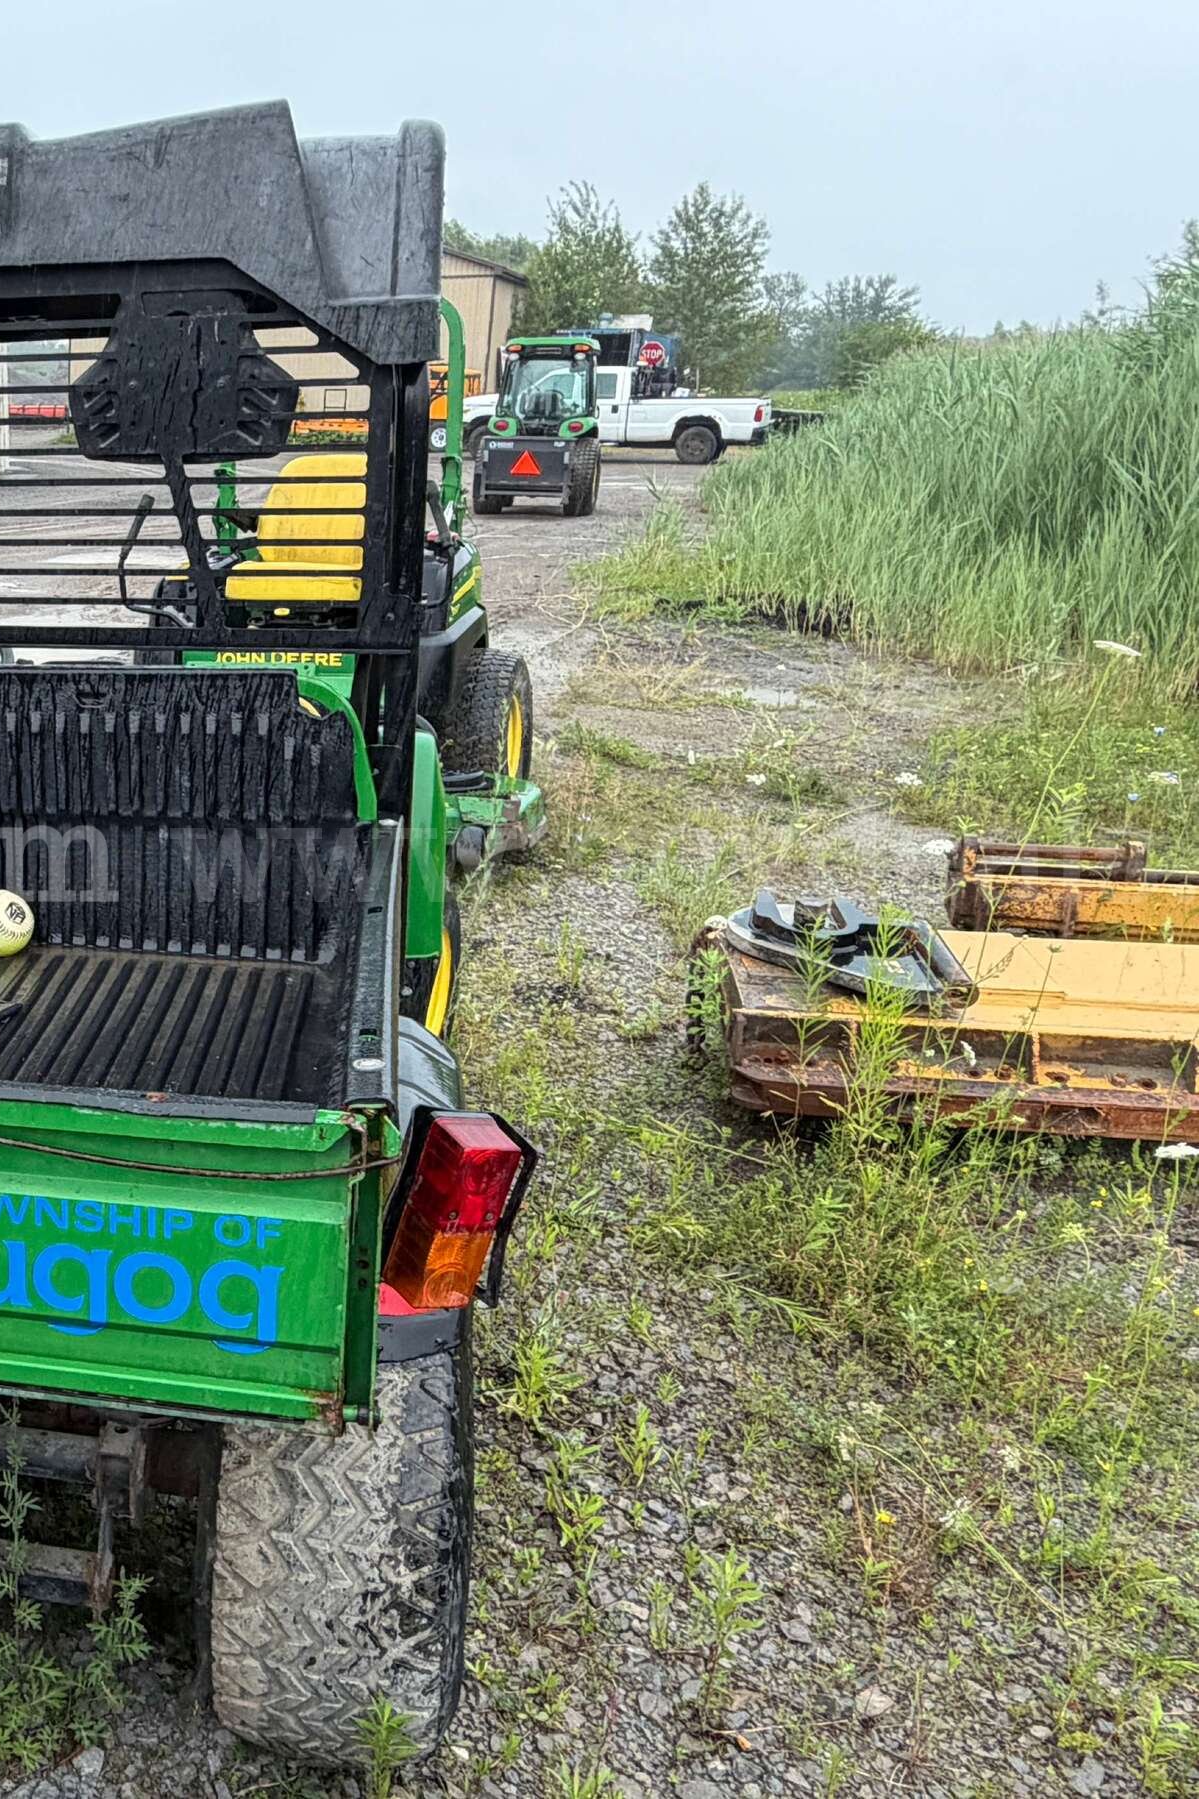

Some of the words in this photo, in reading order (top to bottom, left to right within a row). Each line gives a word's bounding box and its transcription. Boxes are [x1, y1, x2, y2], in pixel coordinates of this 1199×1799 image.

[641, 348, 663, 359] STOP
[216, 651, 266, 664] JOHN
[270, 652, 343, 667] DEERE
[213, 1213, 283, 1249] OF
